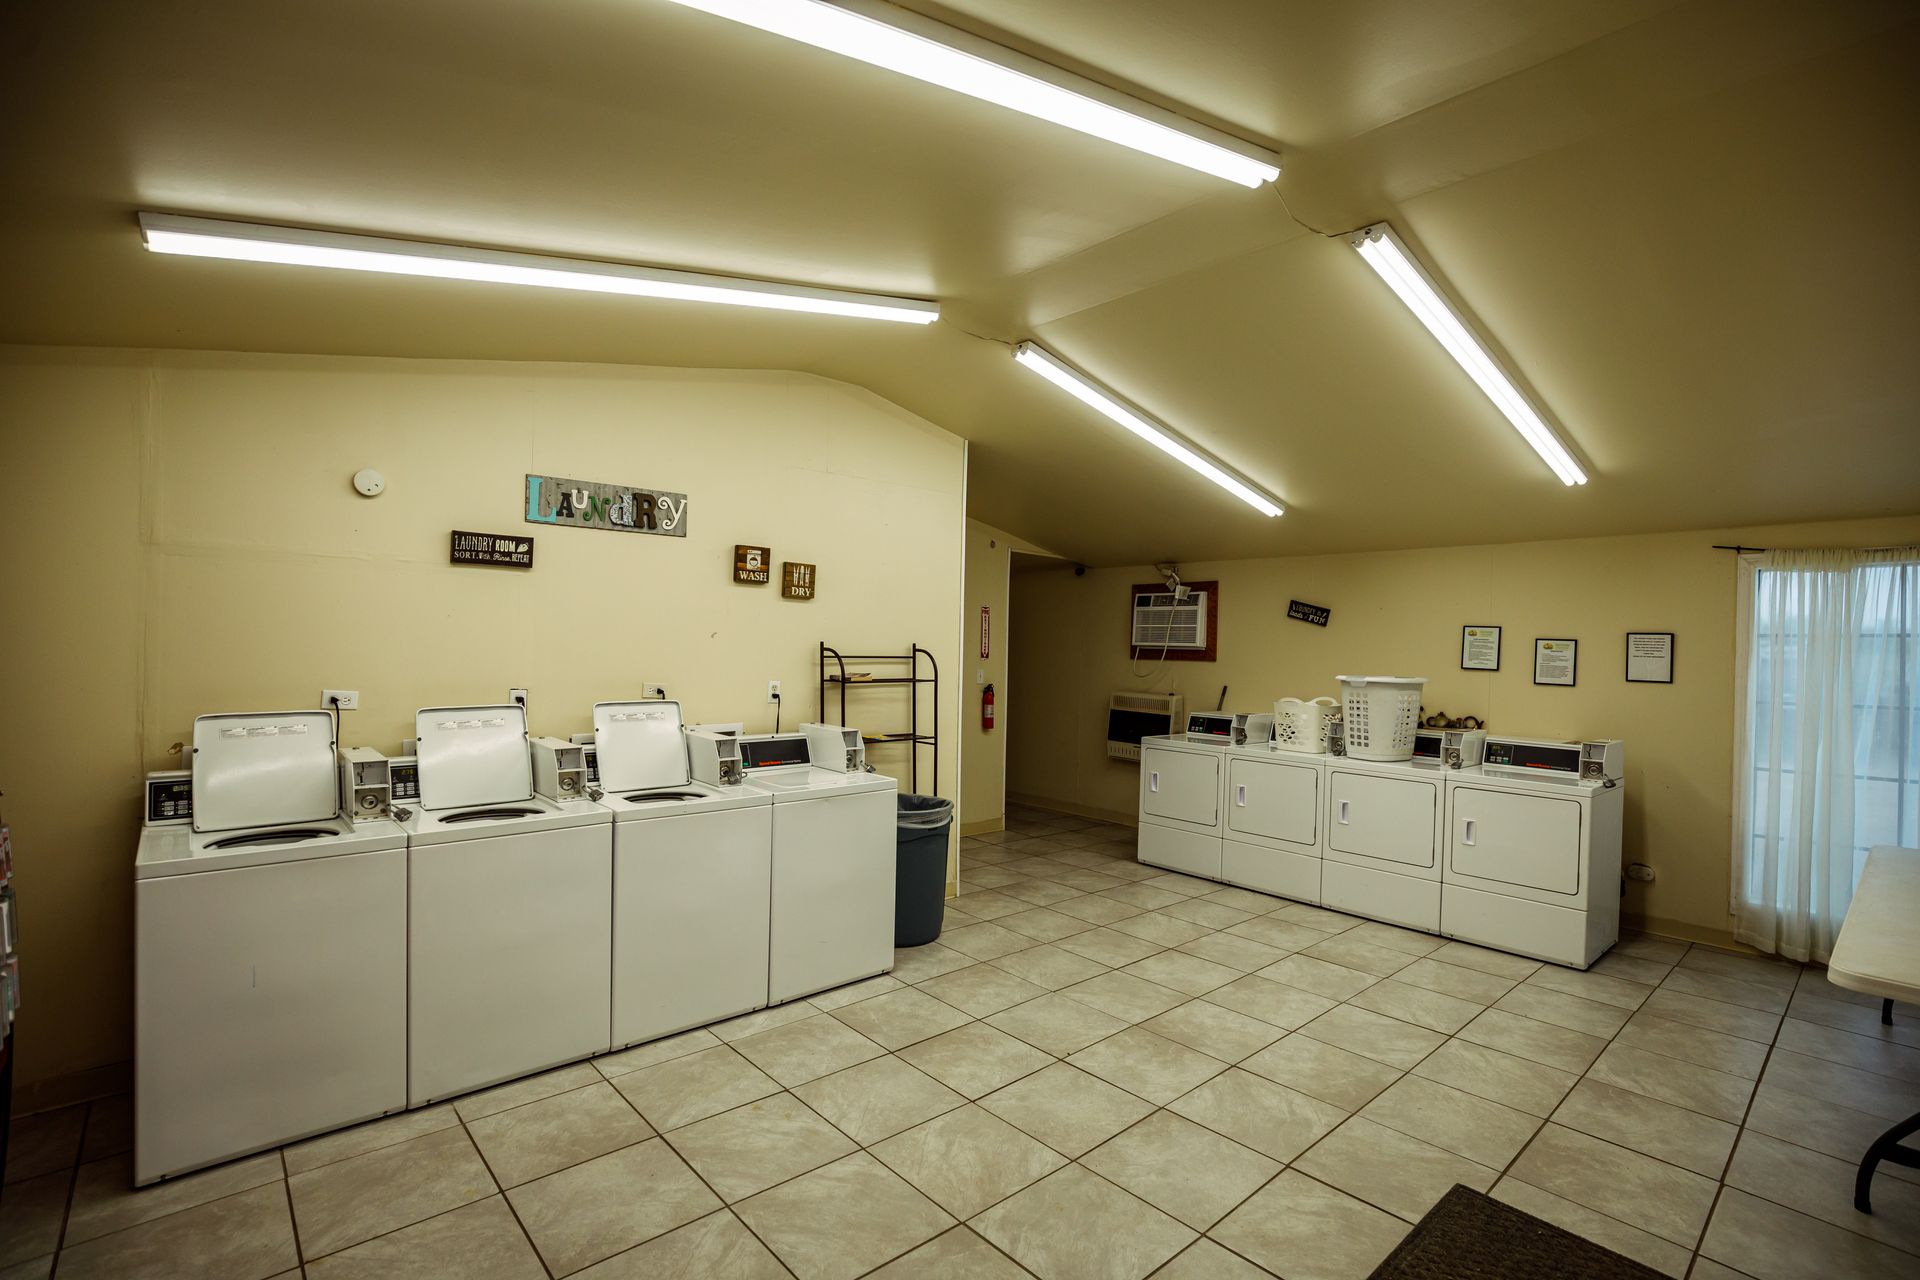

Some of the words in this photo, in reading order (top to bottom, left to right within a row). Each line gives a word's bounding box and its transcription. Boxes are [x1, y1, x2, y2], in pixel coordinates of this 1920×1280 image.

[454, 535, 493, 551] LAUNDRY
[495, 539, 516, 553] ROOM
[511, 553, 530, 563] REPEAT
[738, 570, 768, 582] WASH
[791, 586, 811, 597] DRY
[1308, 614, 1326, 624] FUN
